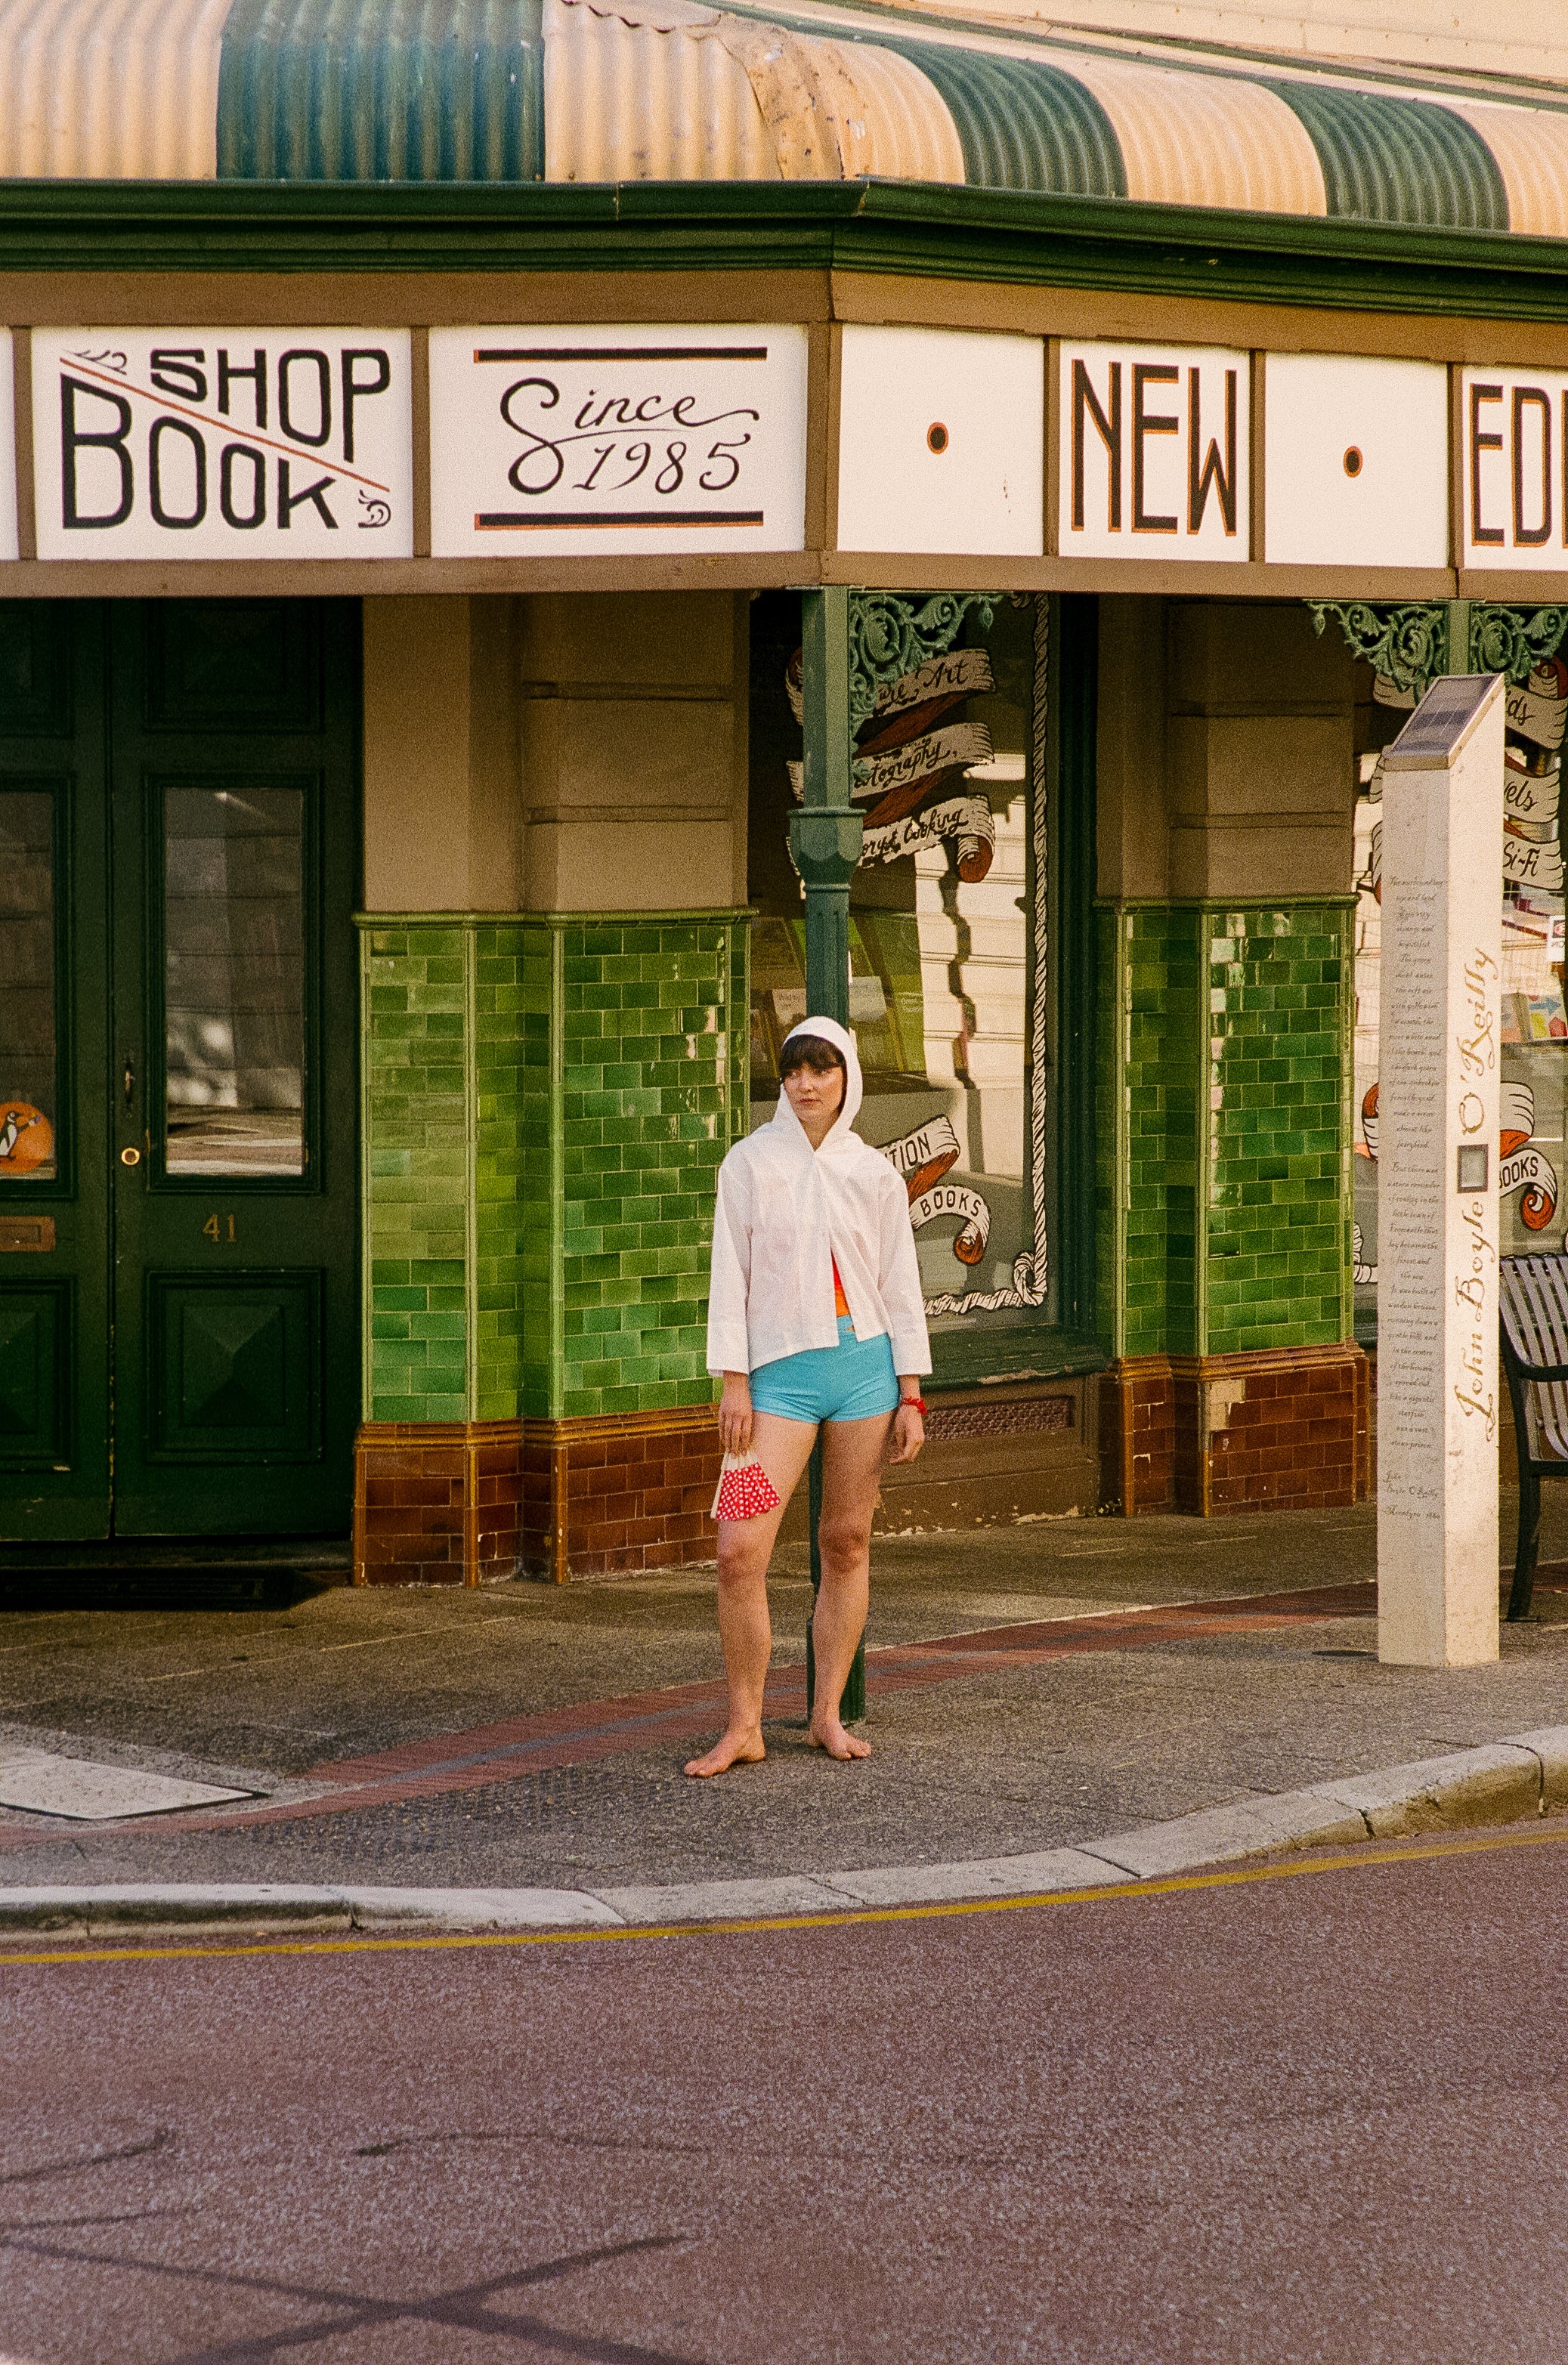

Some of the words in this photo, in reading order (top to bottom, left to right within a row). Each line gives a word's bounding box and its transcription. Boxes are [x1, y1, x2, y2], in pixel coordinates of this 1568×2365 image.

[60, 373, 339, 530] BOOK
[150, 348, 391, 463] SHOP
[499, 377, 760, 496] Since
[1071, 358, 1238, 537] NEW
[1469, 382, 1568, 549] ED
[572, 433, 751, 495] 1985
[914, 660, 969, 689] Art
[854, 737, 957, 790] otography,
[1456, 947, 1498, 1135] O'Reilly
[885, 1132, 932, 1171] TION
[920, 1189, 982, 1217] BOOKS
[203, 1213, 237, 1243] 41
[1454, 1201, 1495, 1322] Boyle
[1454, 1332, 1496, 1442] John
